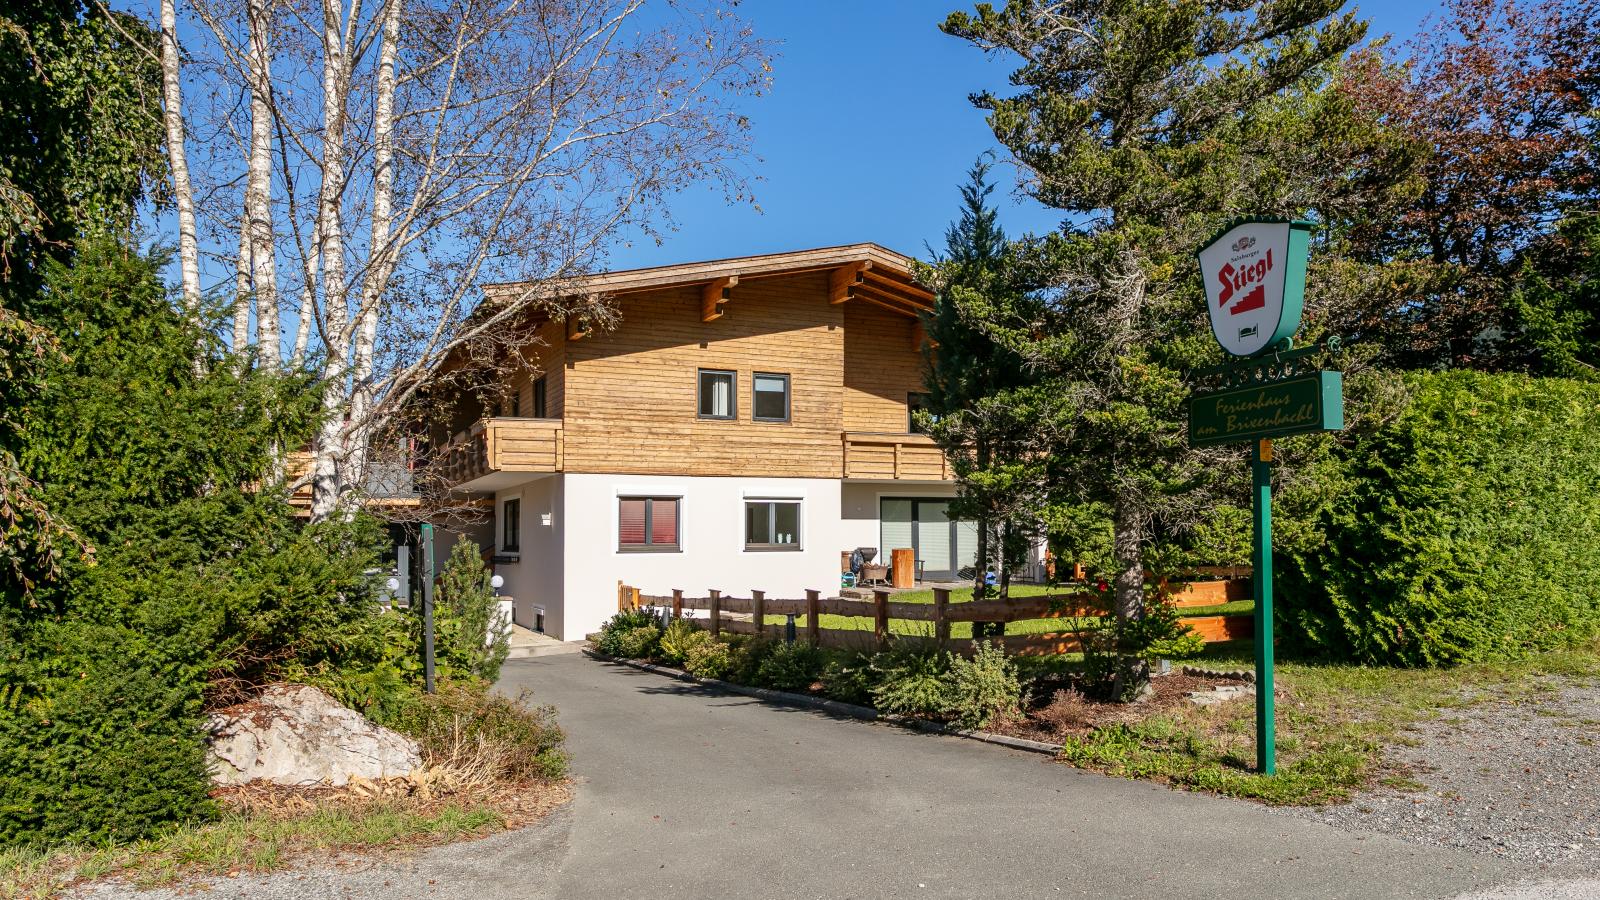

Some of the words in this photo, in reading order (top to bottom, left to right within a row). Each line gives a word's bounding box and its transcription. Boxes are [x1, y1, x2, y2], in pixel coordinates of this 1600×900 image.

[1231, 249, 1260, 262] Salzburger
[1218, 248, 1273, 308] Stiegl
[1216, 392, 1290, 416] Ferienhaus
[1197, 425, 1217, 435] am
[1226, 403, 1313, 432] Brixenbachl
